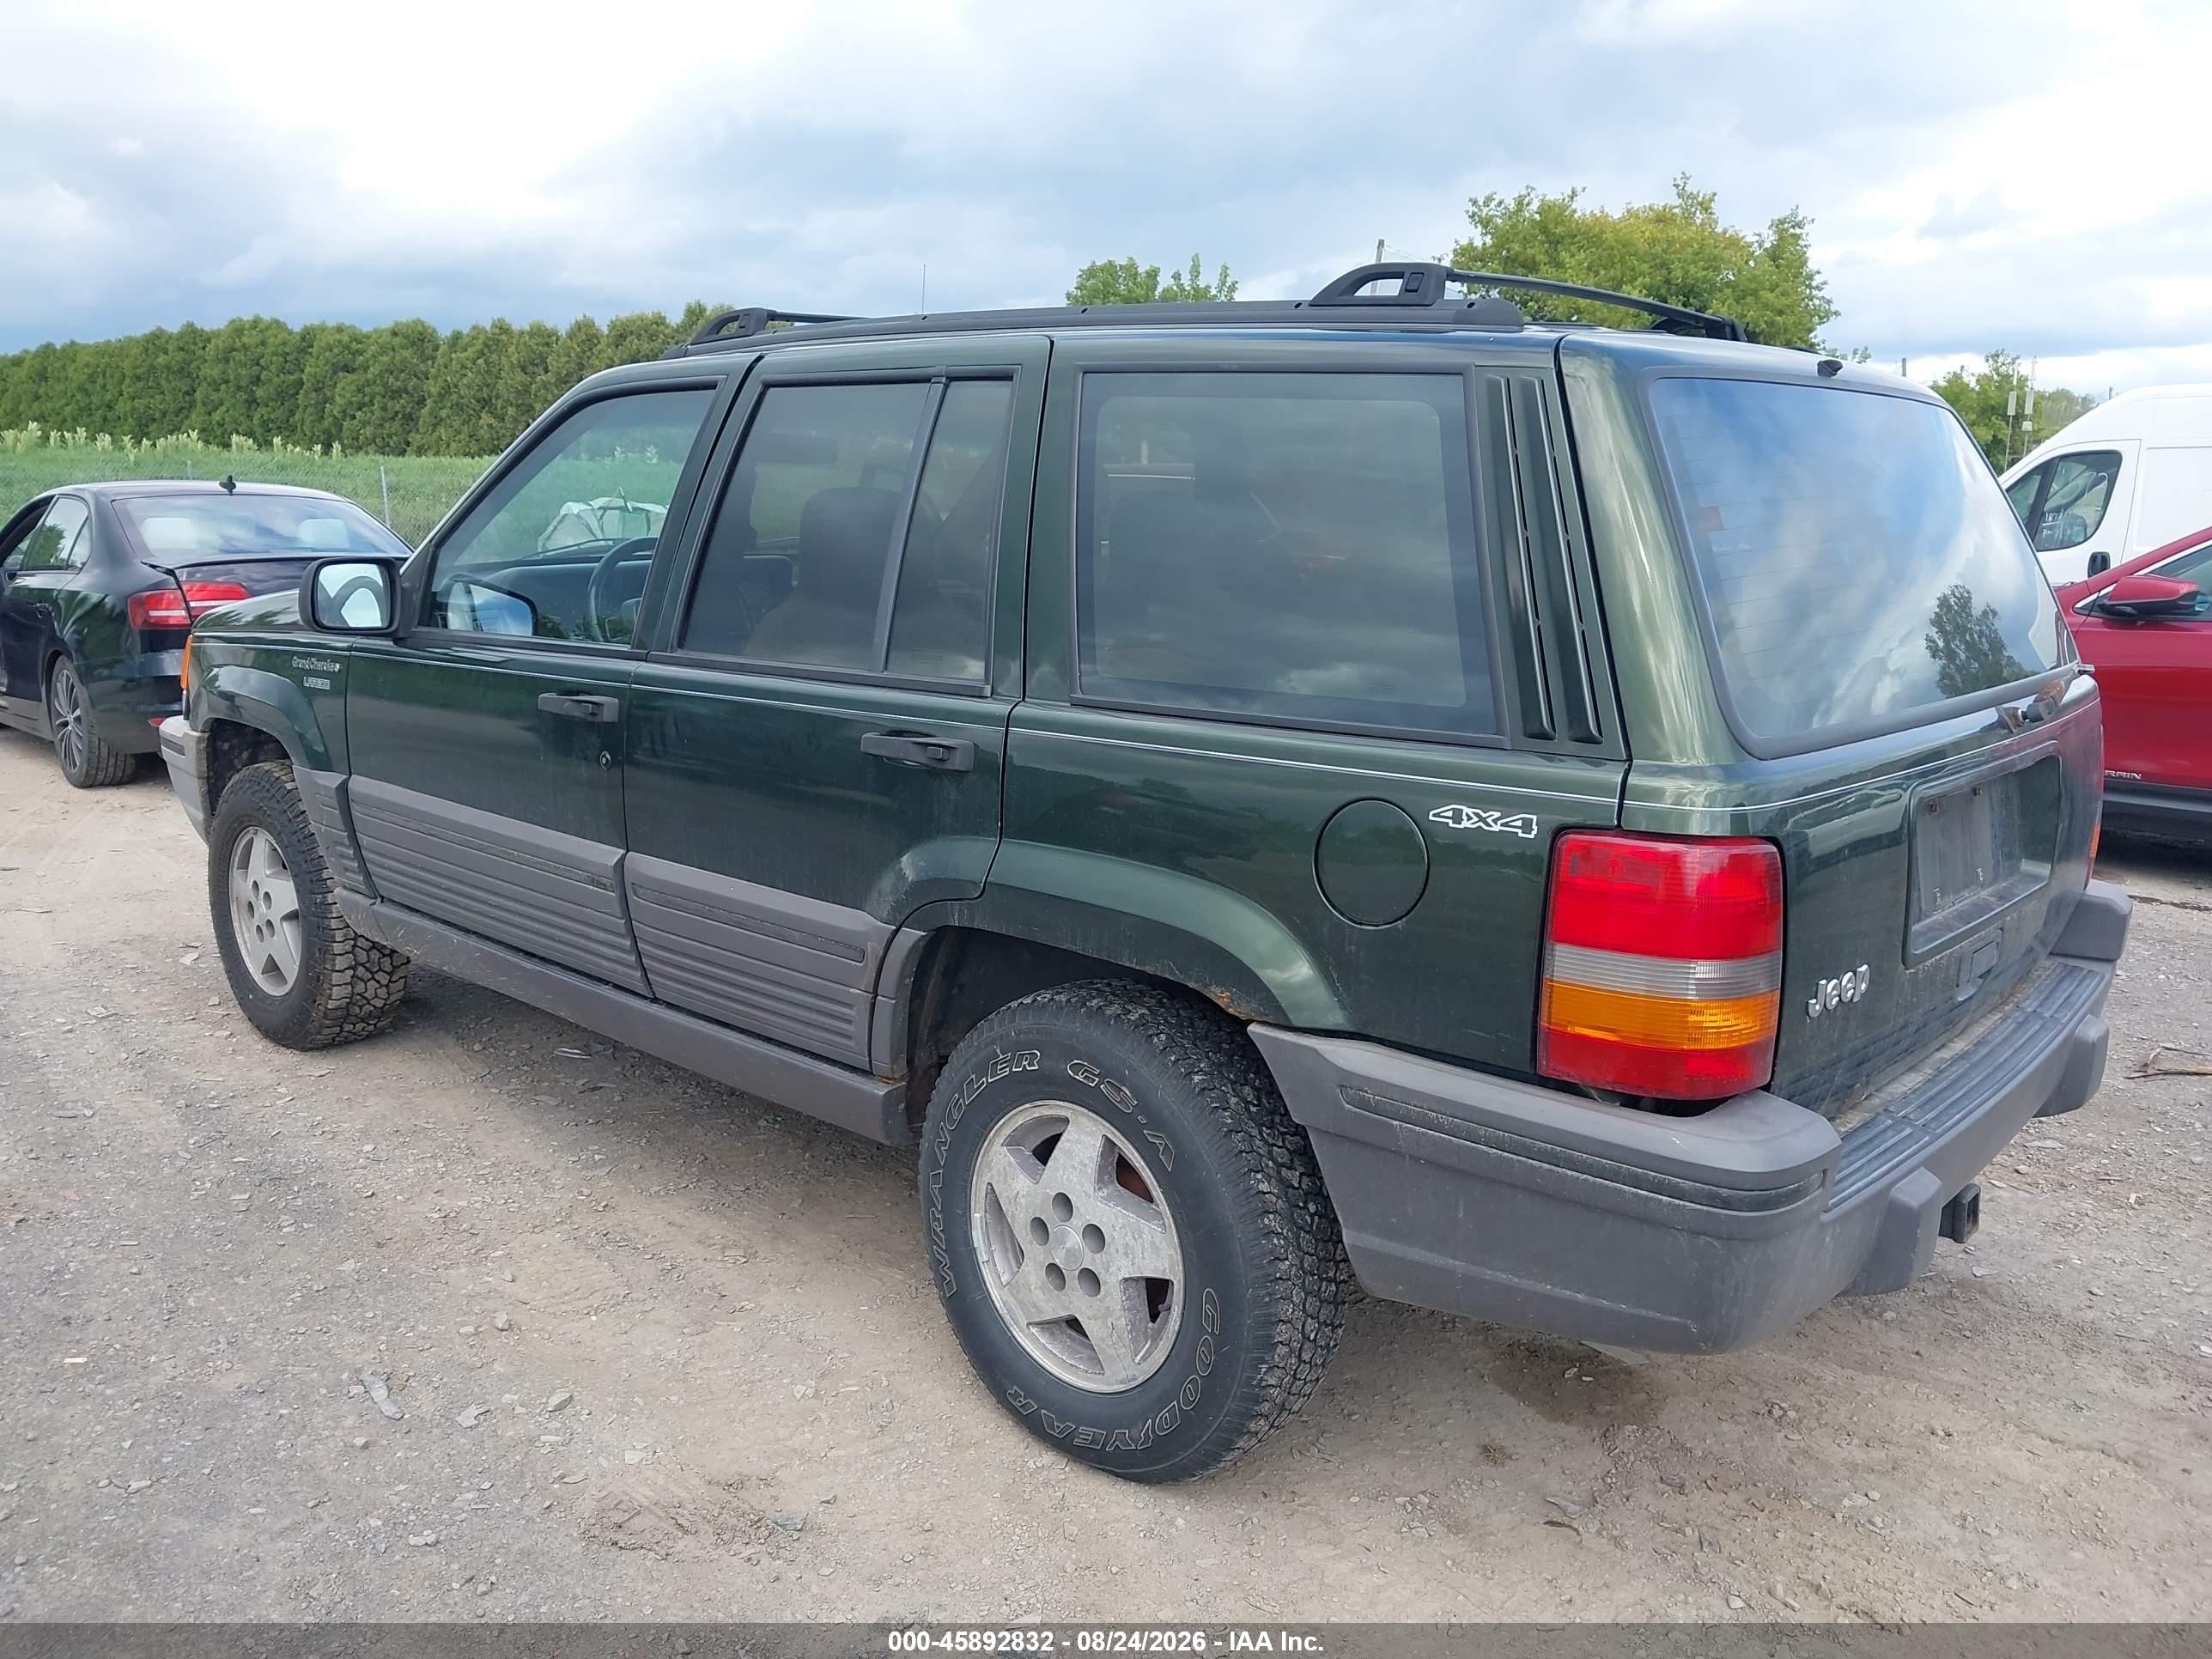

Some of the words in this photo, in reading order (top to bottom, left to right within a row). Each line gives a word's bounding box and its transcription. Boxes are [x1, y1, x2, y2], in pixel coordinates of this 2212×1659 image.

[1808, 963, 1870, 1018] Jeep
[928, 1048, 1041, 1298] WRANGLER
[1006, 1287, 1221, 1451] GOODYEAR
